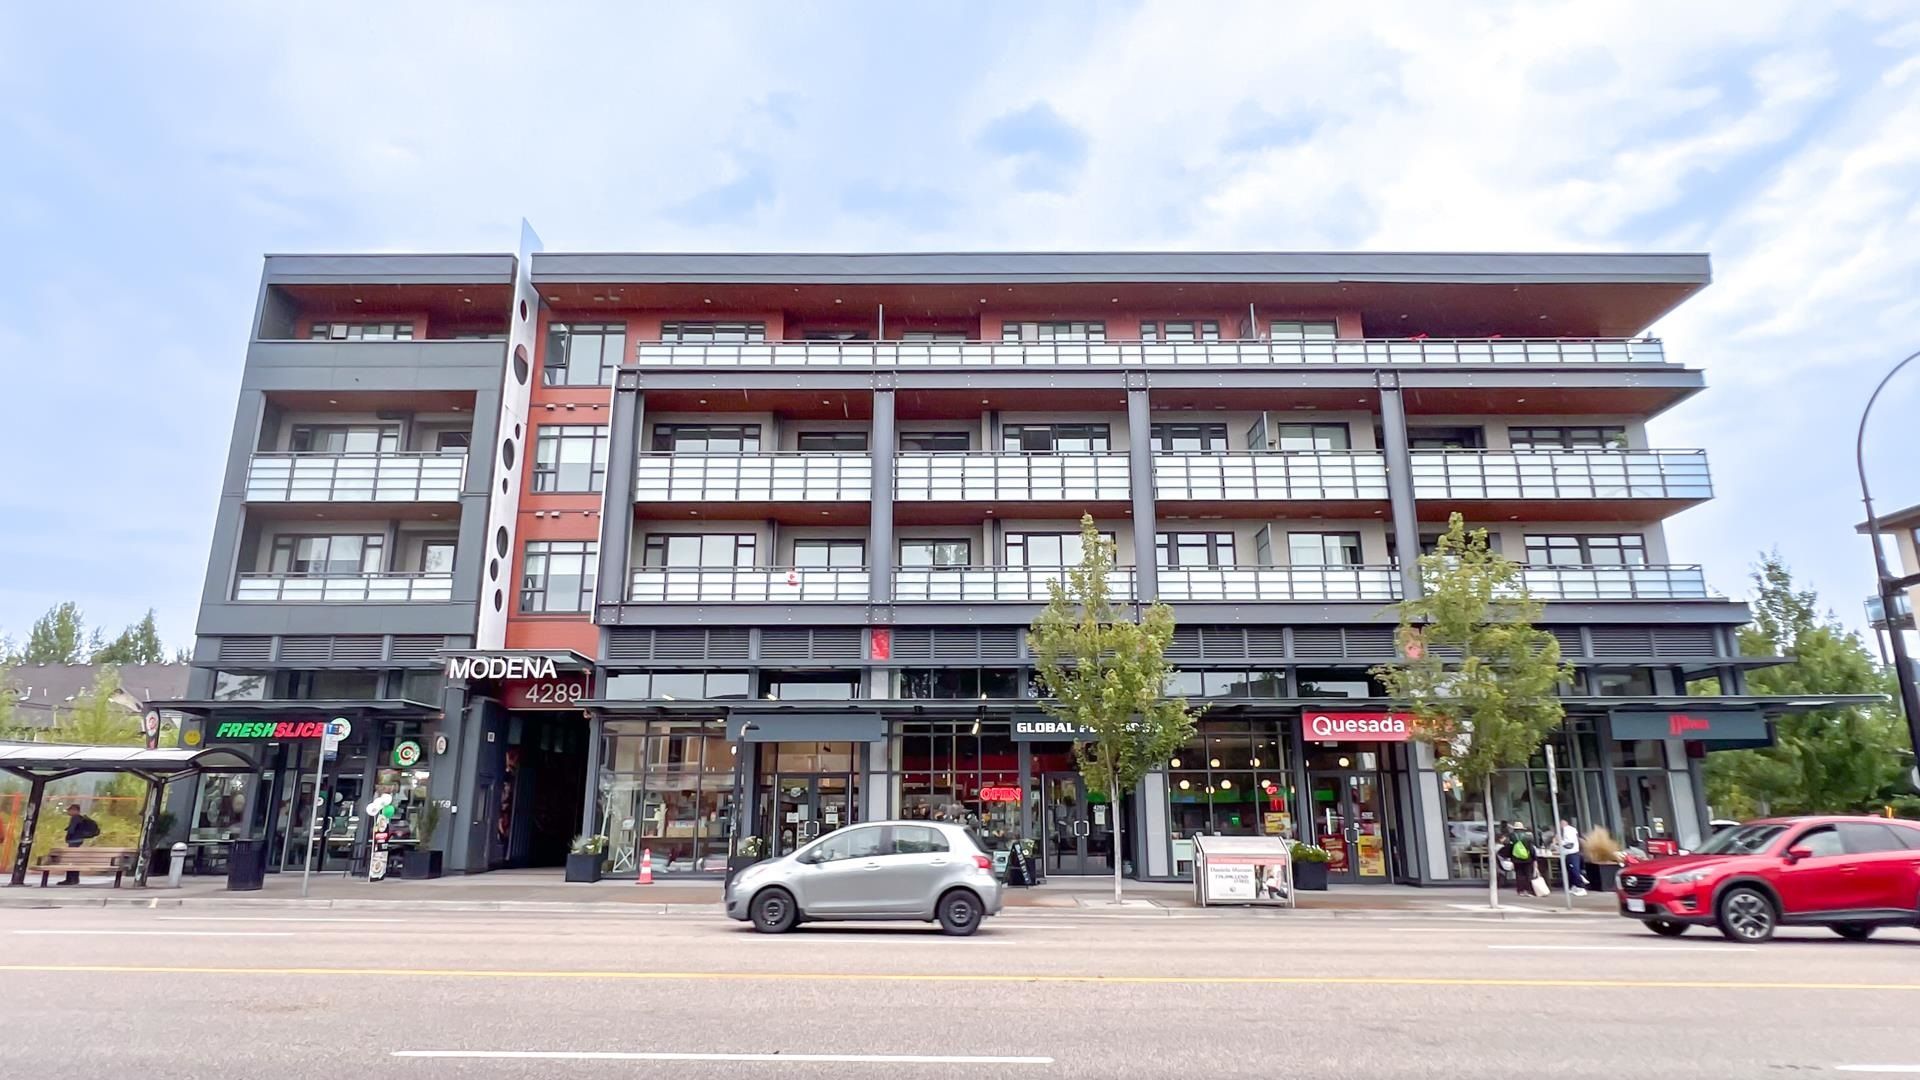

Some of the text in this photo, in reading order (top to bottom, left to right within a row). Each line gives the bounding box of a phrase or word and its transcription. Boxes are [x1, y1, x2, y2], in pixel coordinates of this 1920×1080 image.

[449, 658, 558, 679] MODENA
[525, 683, 582, 703] 4289
[216, 722, 324, 738] FRESHSLICE
[1016, 722, 1075, 733] GLOBAL
[1312, 716, 1405, 736] Quesada
[980, 787, 1022, 800] OPEN
